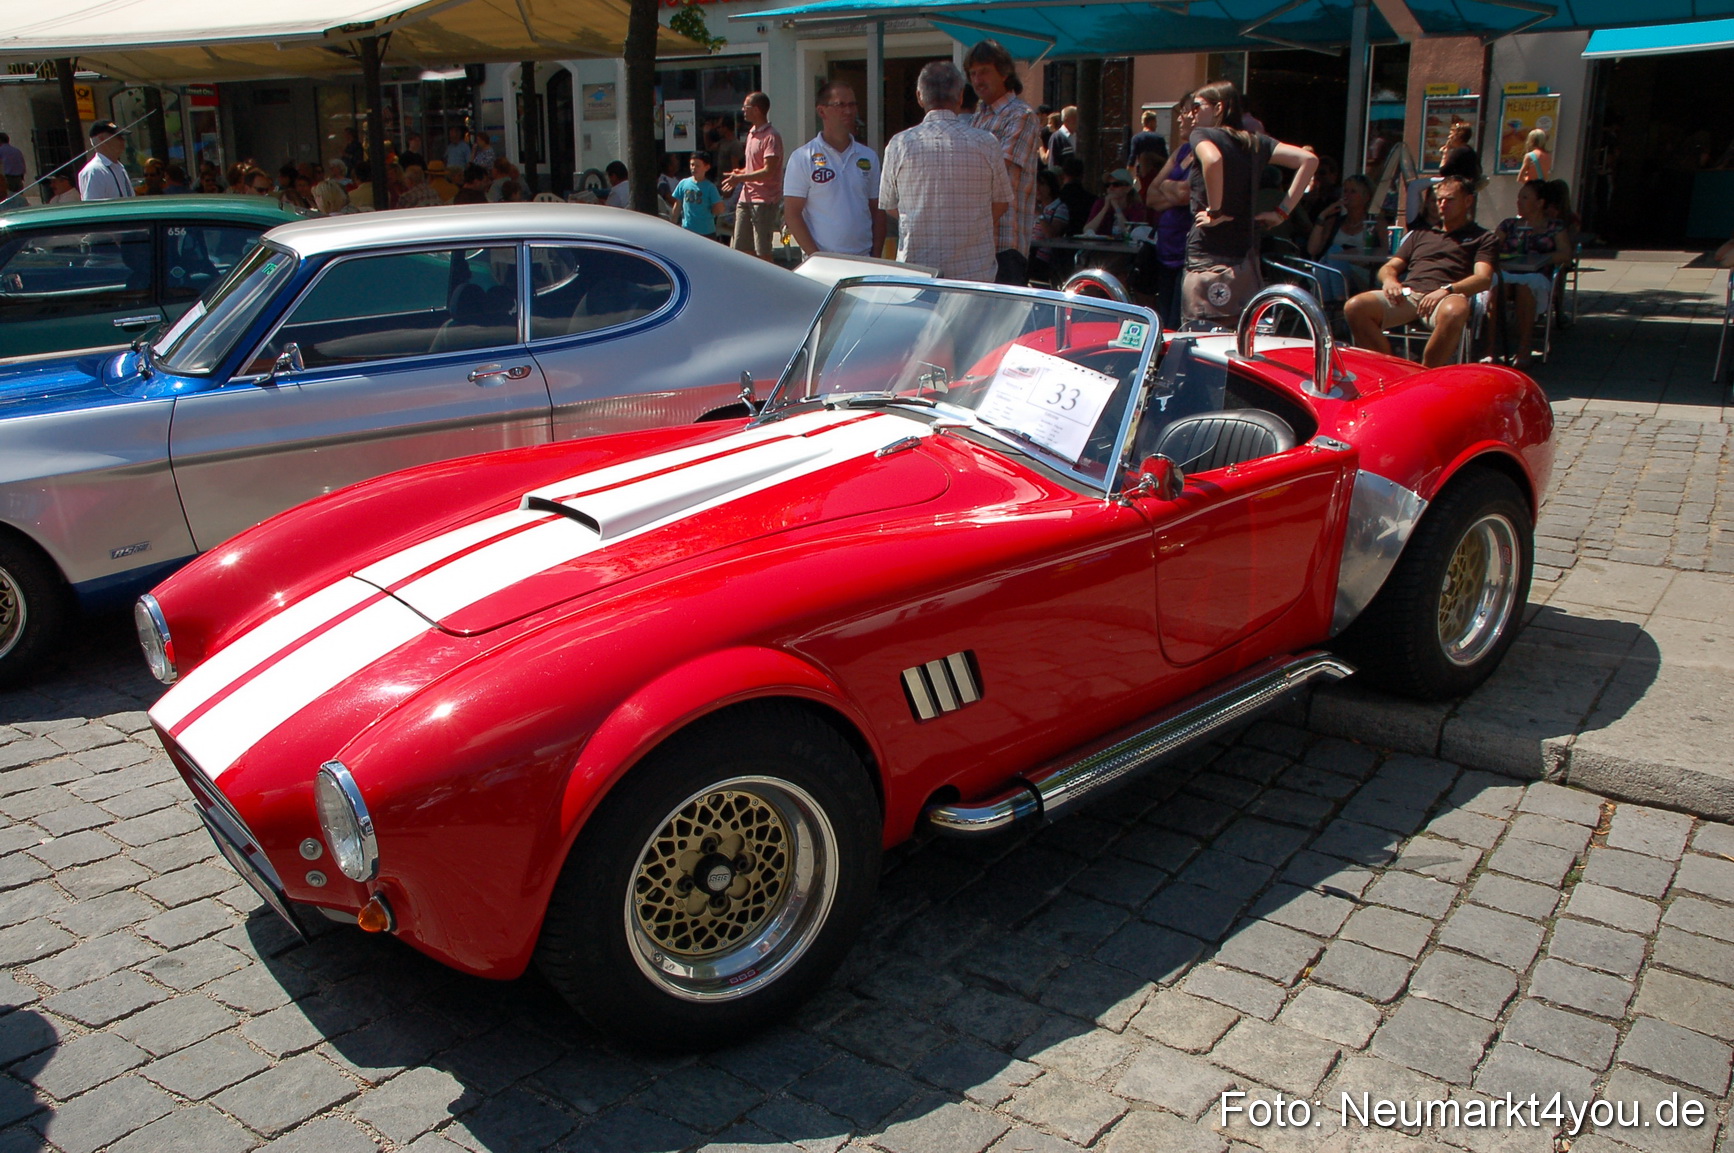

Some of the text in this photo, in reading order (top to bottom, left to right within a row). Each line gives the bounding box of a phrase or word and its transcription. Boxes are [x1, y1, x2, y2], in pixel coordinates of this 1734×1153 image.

[814, 169, 834, 182] STP
[167, 227, 187, 236] 656
[1046, 383, 1081, 411] 33
